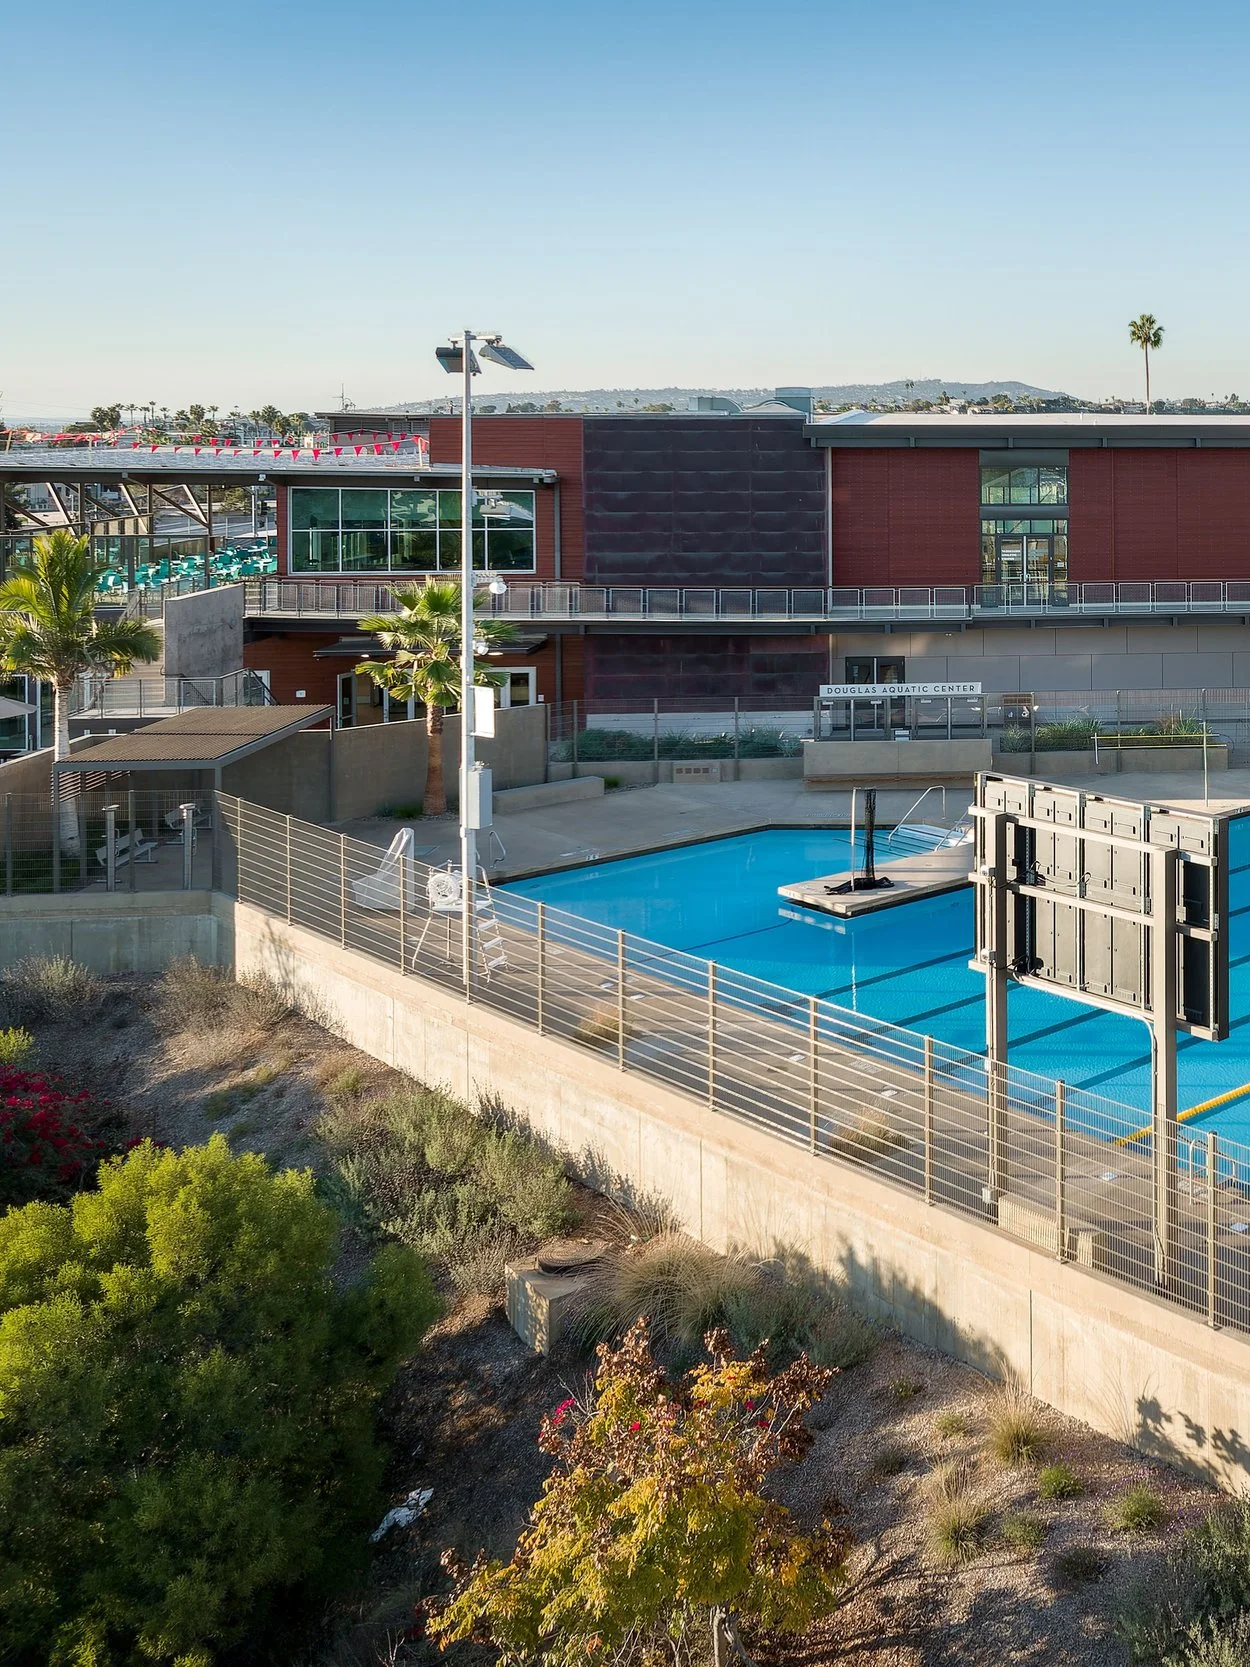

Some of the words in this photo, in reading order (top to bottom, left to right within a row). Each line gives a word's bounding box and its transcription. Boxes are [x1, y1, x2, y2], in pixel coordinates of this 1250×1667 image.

[826, 686, 877, 695] DOUGLAS
[882, 685, 929, 694] AQUATIC
[933, 684, 975, 693] CENTER
